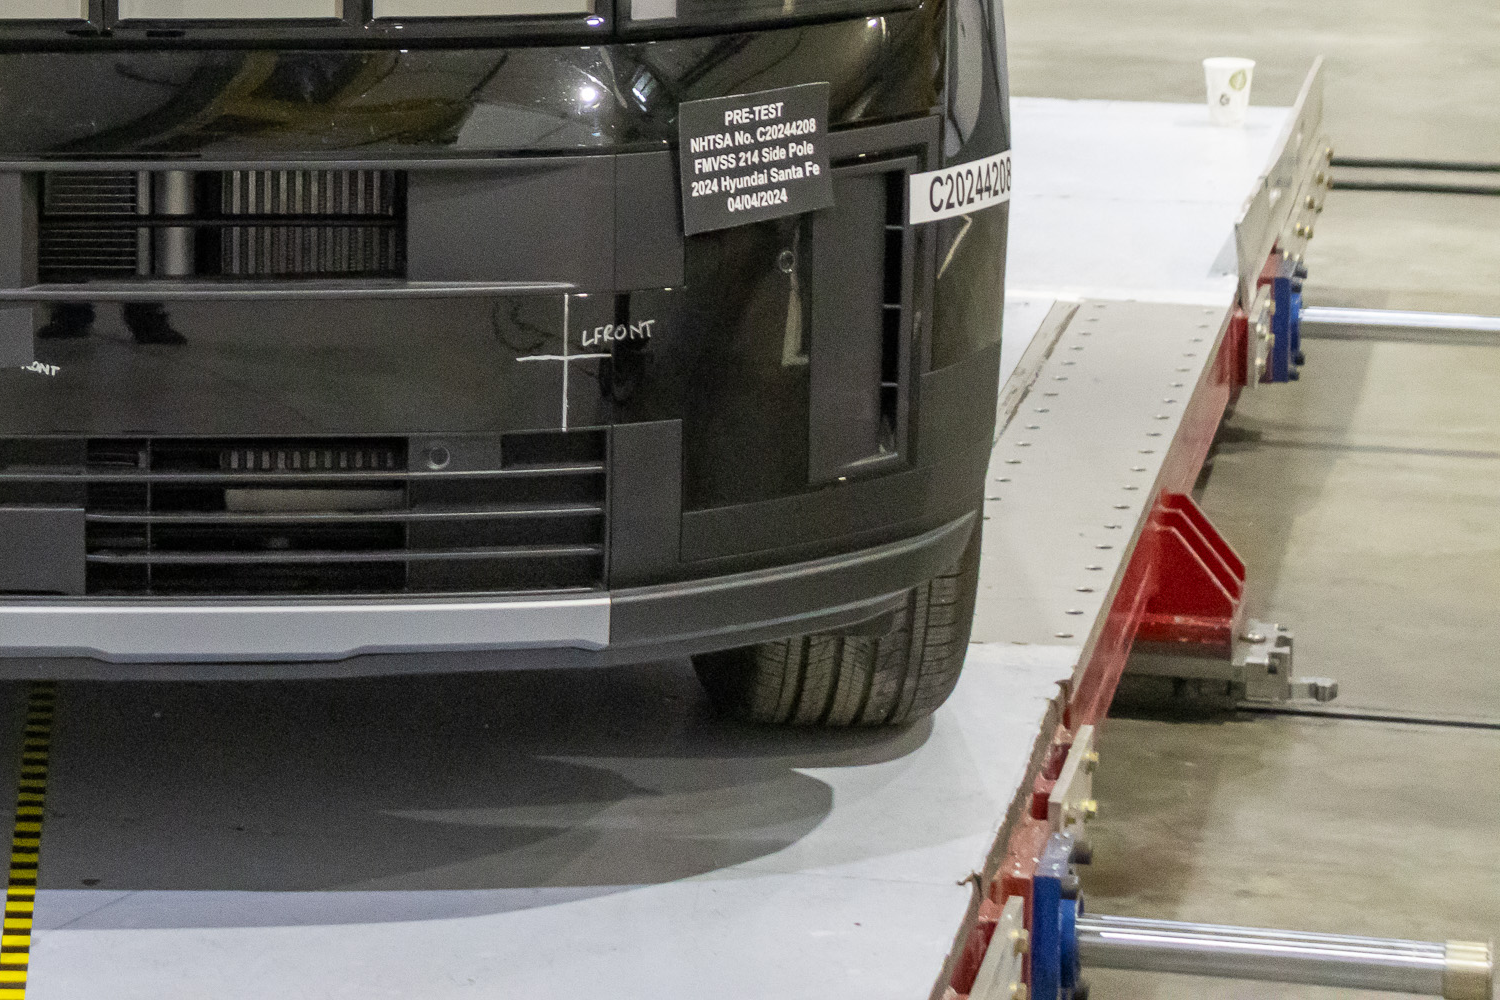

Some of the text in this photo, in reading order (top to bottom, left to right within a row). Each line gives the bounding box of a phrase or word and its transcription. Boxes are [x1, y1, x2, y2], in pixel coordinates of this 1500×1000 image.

[724, 102, 784, 126] PRE-TEST
[690, 118, 817, 153] NHTSA No. C20244208
[694, 141, 814, 175] FMVSS 214 Side Pole
[691, 161, 820, 197] 2024 Hyundai Santa Fe
[929, 157, 1011, 213] C20244208
[727, 188, 789, 212] 04/04/2024
[582, 319, 656, 347] LFRONT
